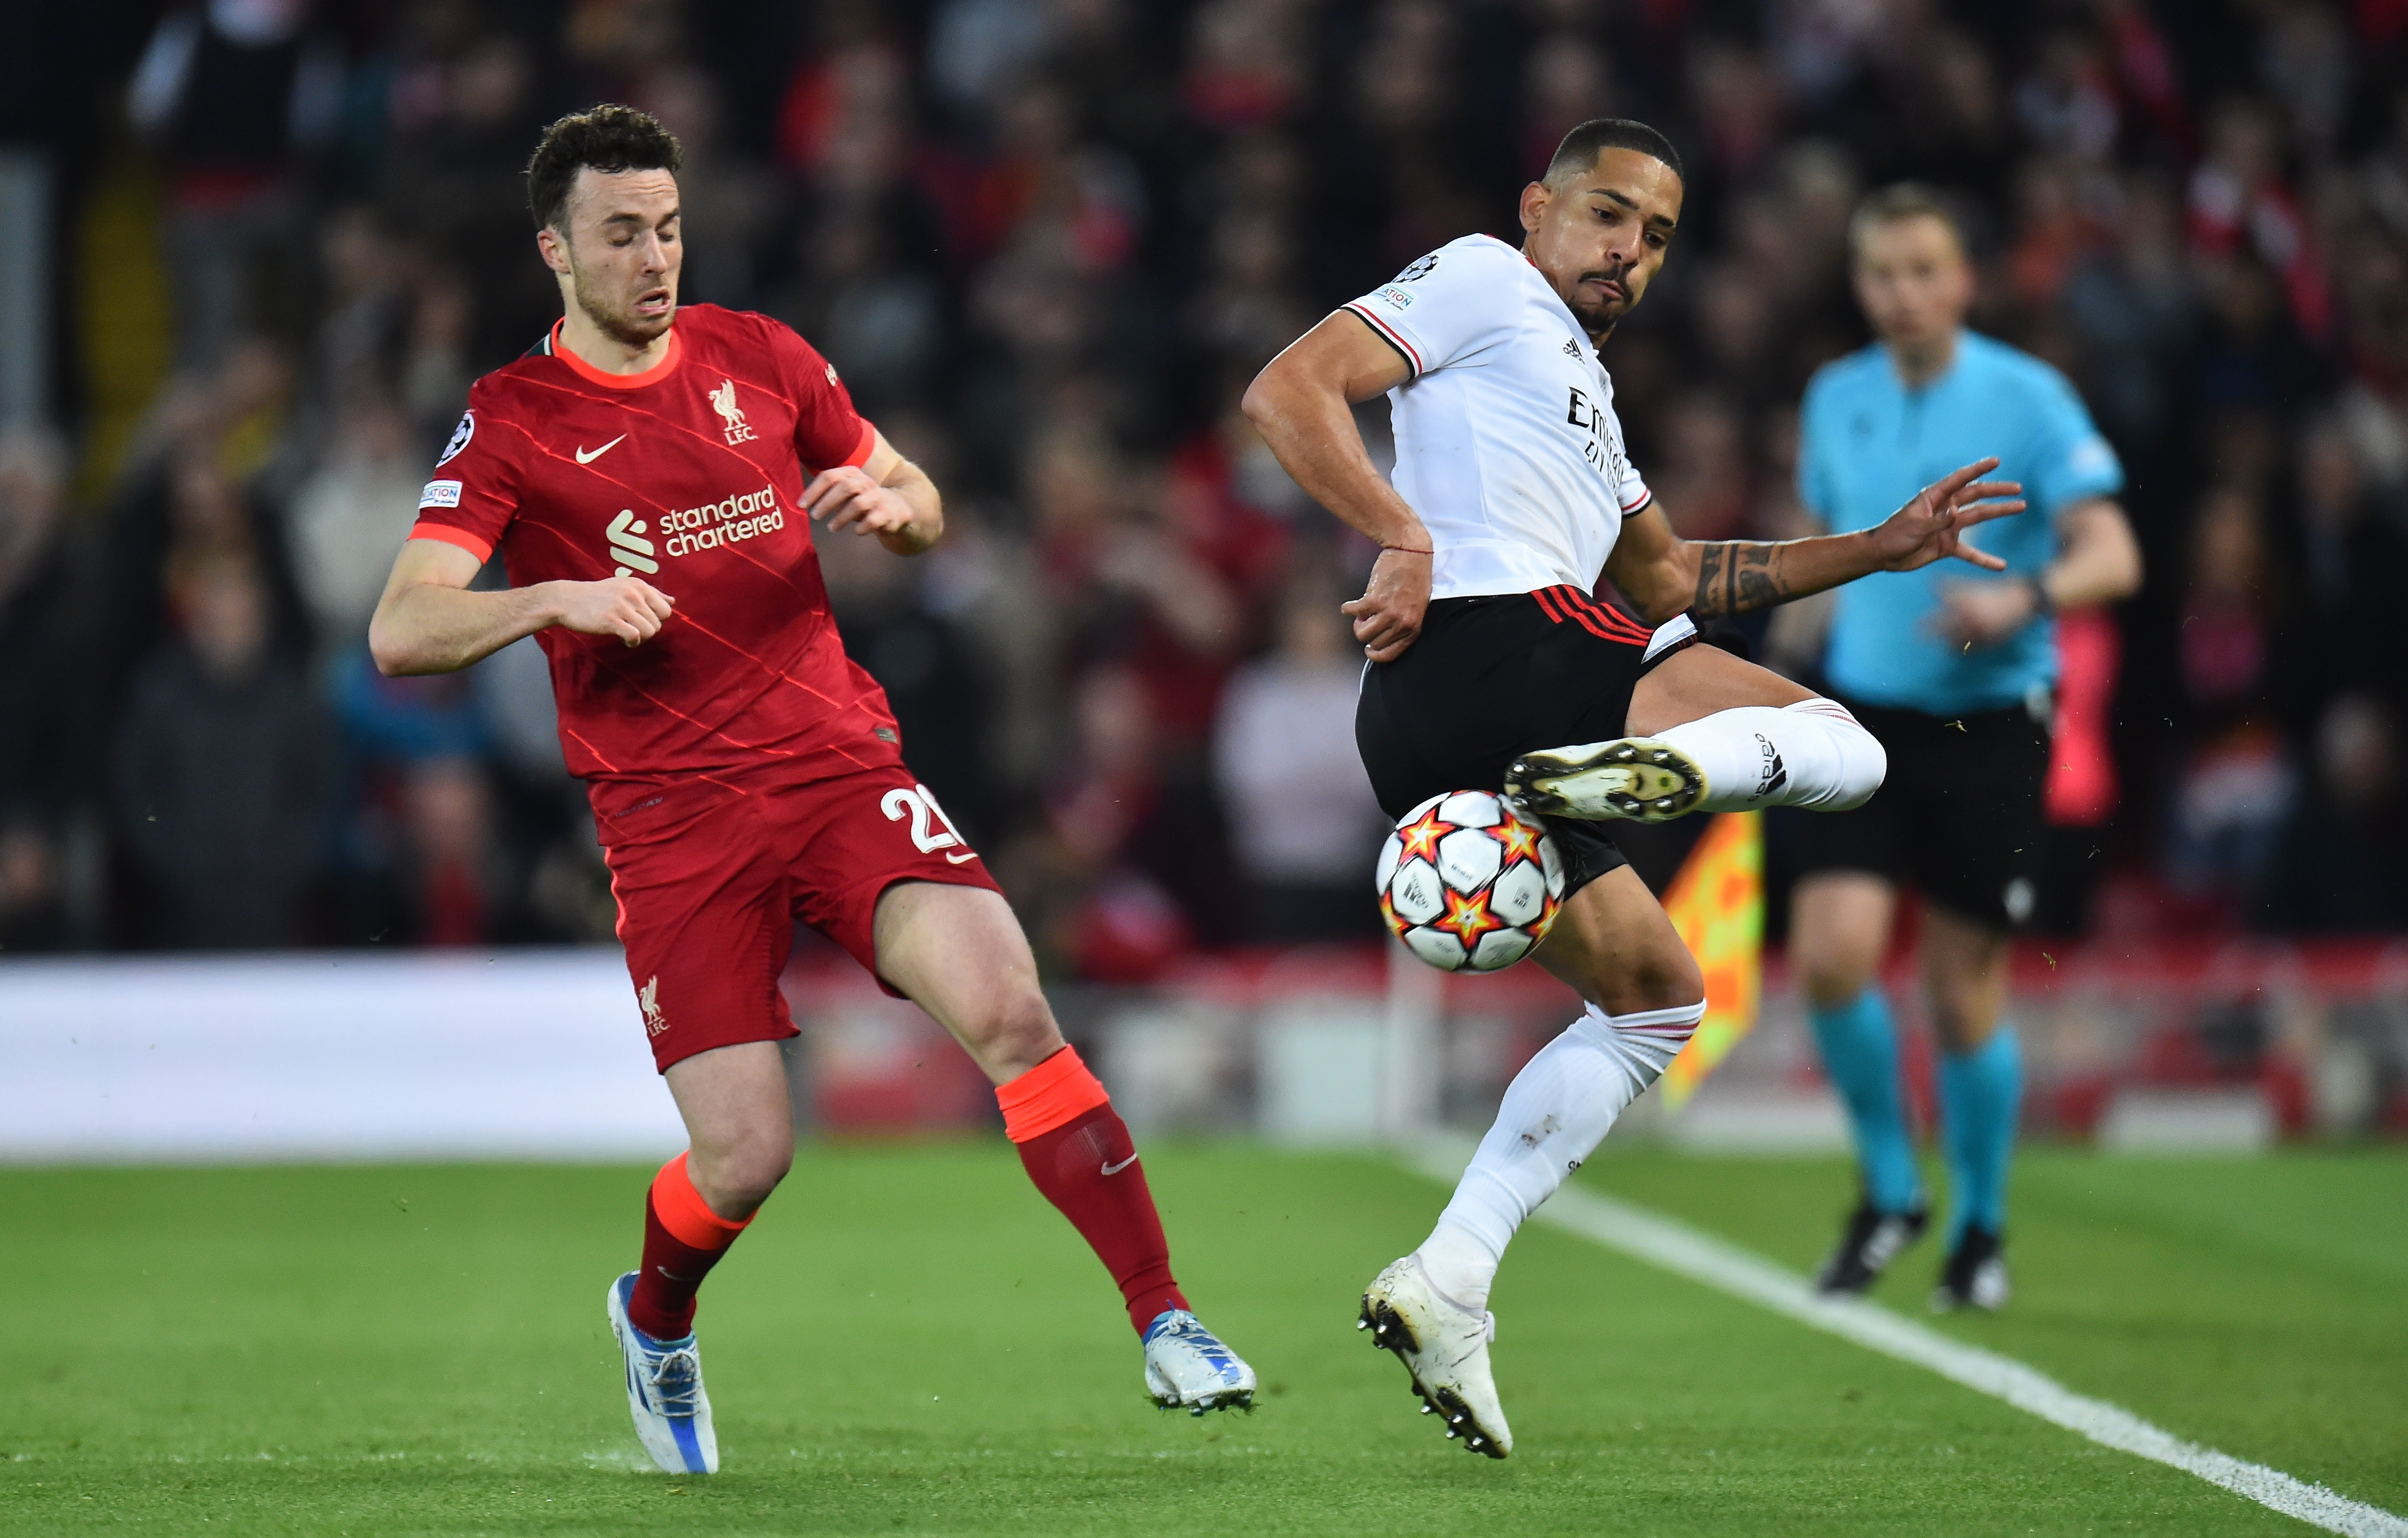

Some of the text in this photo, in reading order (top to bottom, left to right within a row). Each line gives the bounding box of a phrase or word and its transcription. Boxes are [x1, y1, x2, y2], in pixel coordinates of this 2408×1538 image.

[1382, 288, 1412, 307] ATION
[660, 483, 775, 534] standard
[666, 506, 784, 556] chartered
